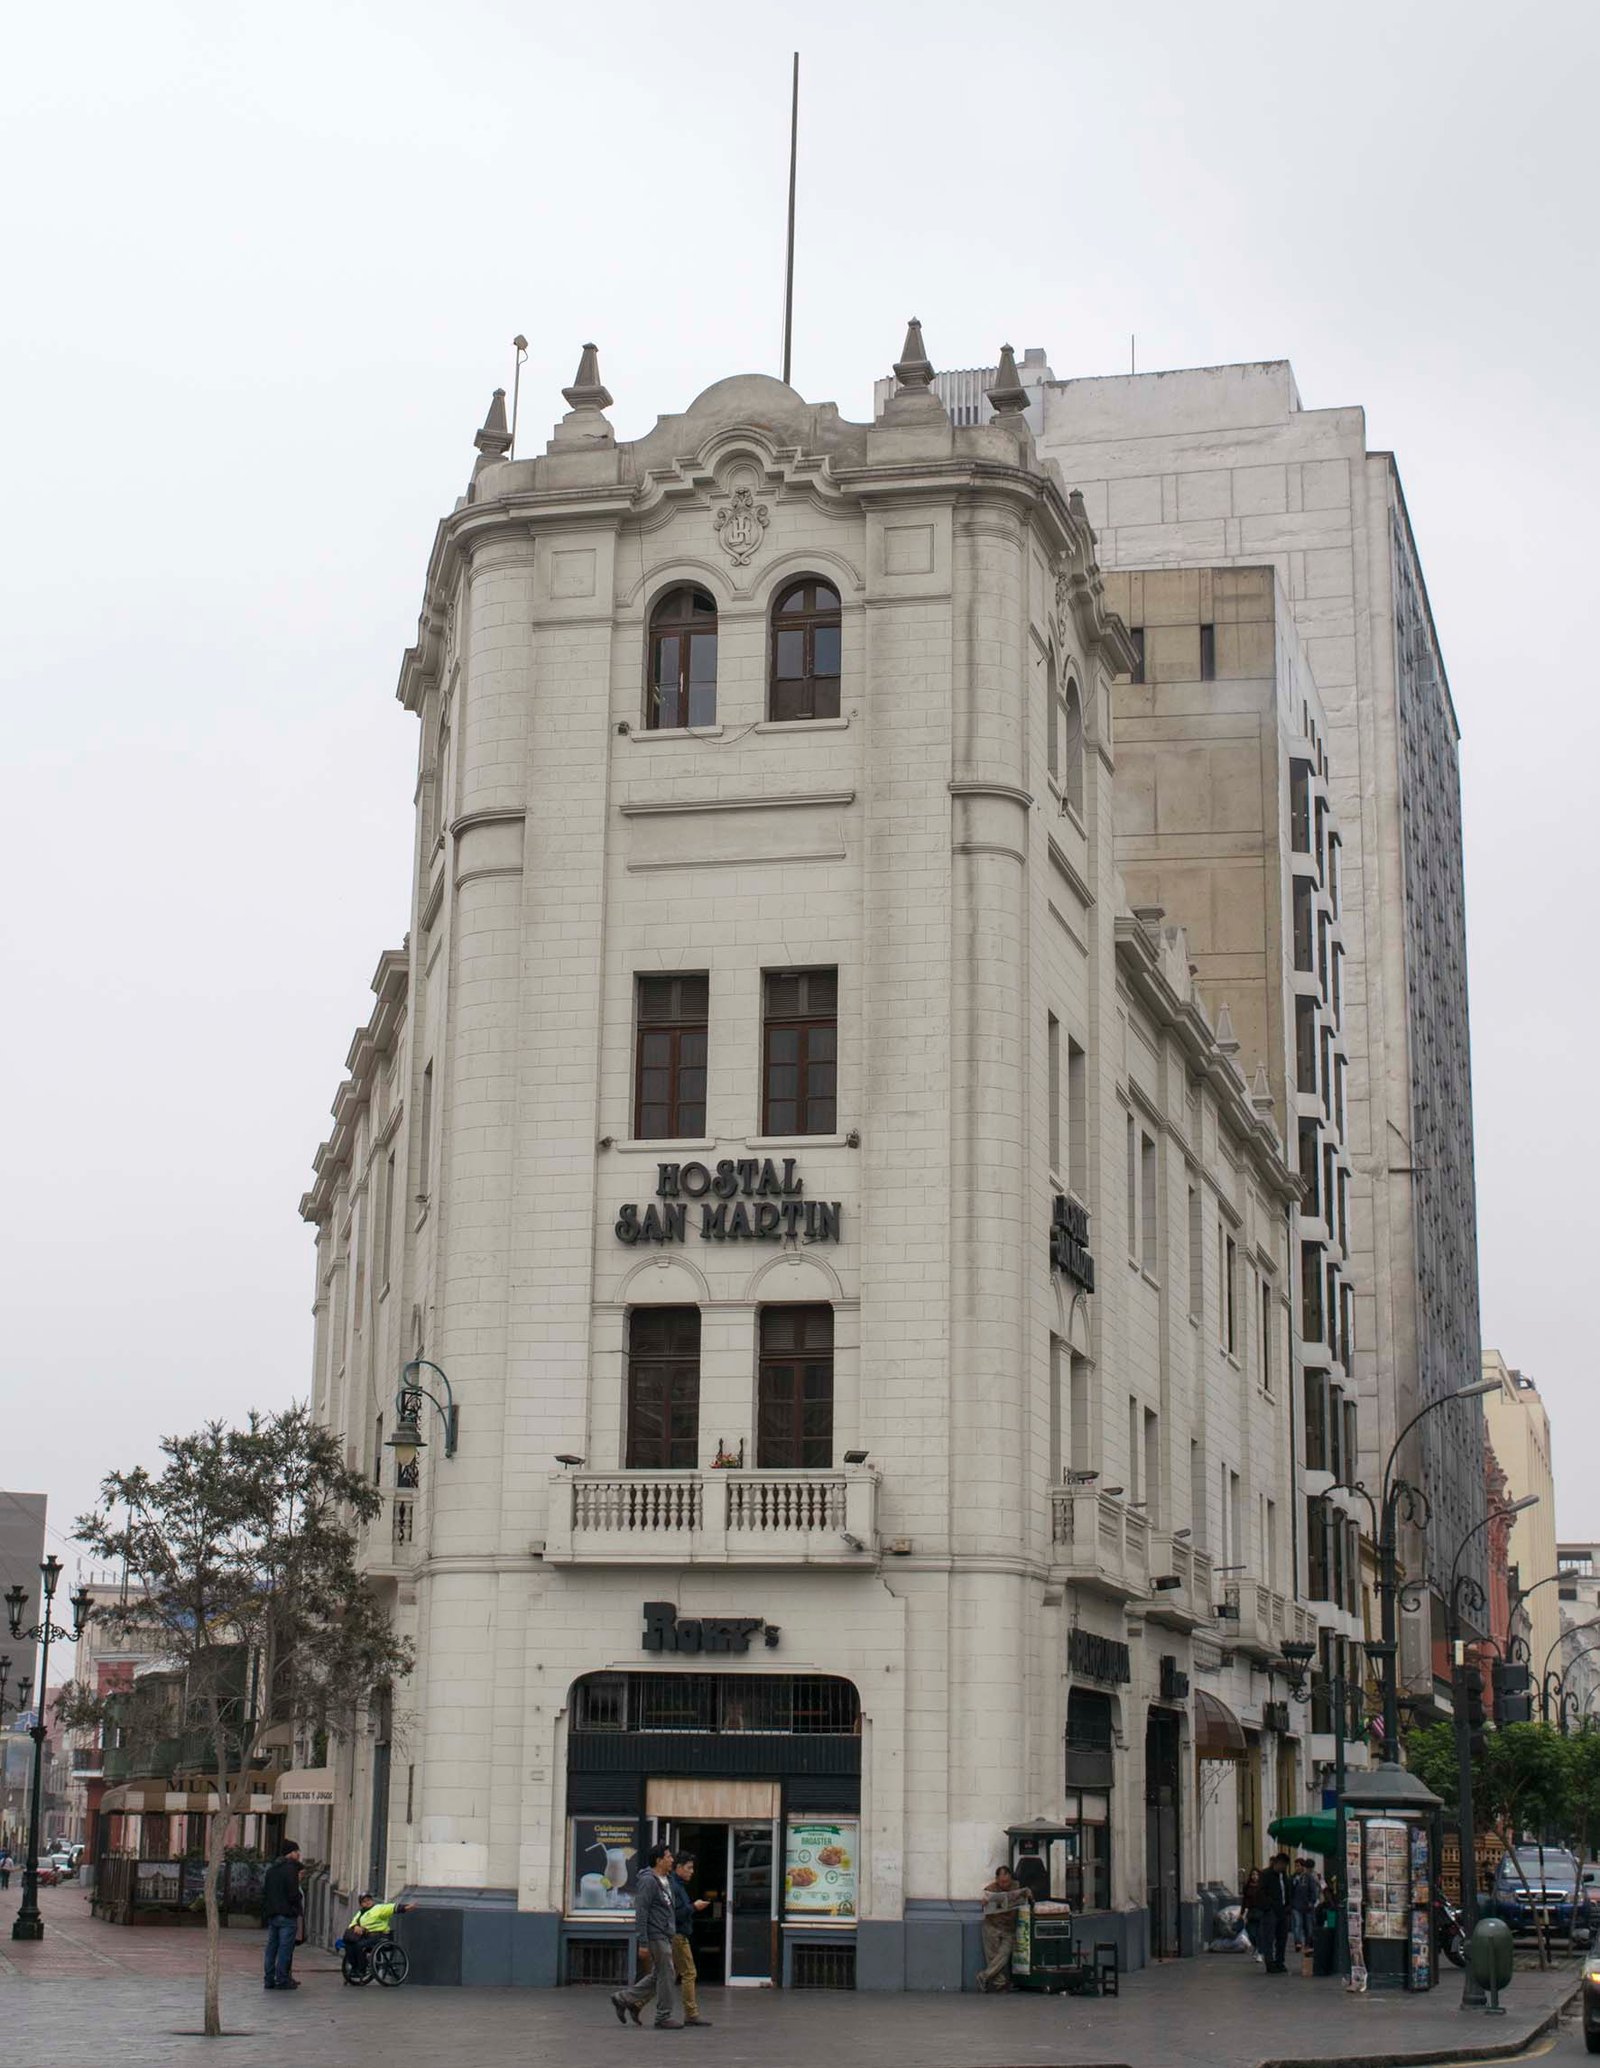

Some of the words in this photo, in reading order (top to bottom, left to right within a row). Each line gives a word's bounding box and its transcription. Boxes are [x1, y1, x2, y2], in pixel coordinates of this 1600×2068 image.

[656, 1158, 803, 1199] HOSTAL
[615, 1203, 687, 1243] SAN
[700, 1200, 841, 1244] MARTIN
[166, 1779, 267, 1795] MUNIH
